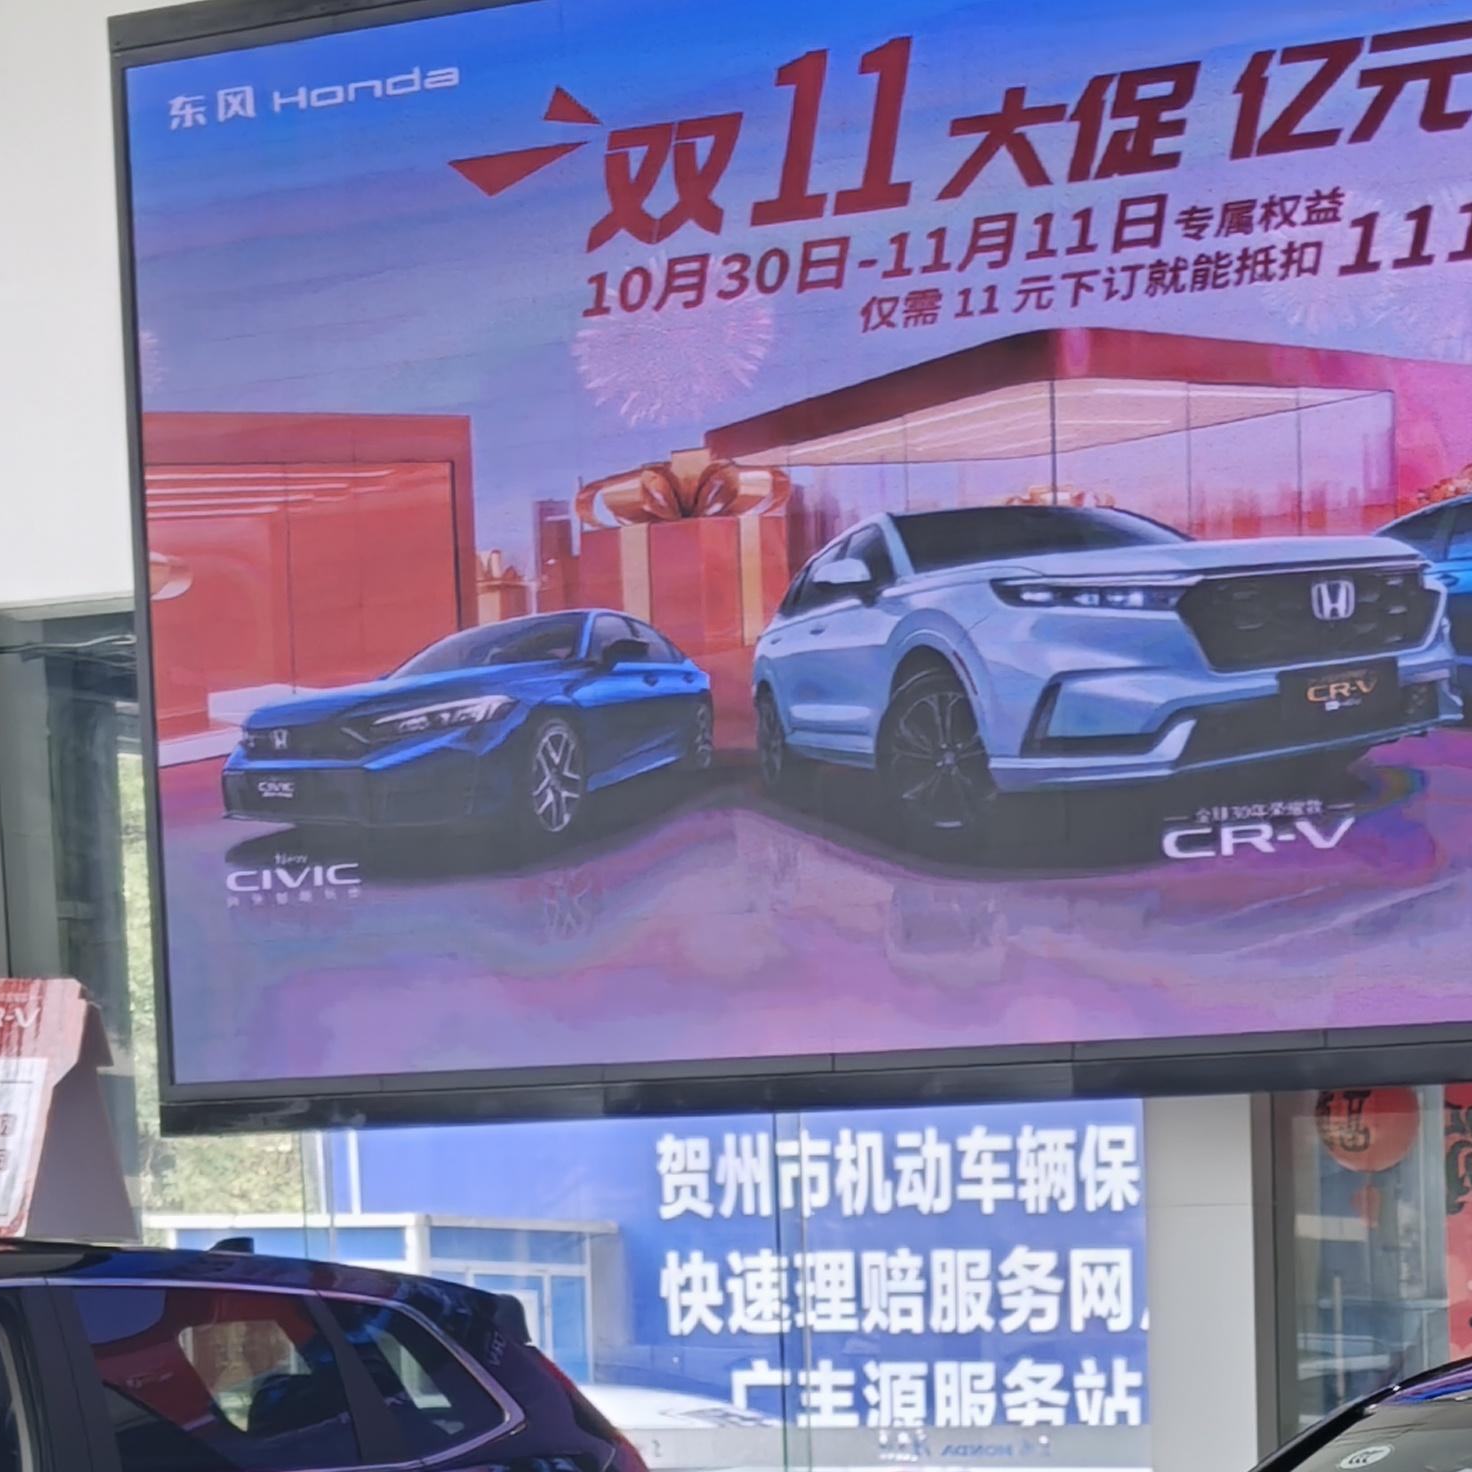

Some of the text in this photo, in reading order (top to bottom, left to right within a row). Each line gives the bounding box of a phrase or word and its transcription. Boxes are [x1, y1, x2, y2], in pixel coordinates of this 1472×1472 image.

[168, 66, 460, 131] 东风 Honda
[1306, 678, 1377, 703] CR-V
[1162, 816, 1356, 860] CR-V
[226, 863, 362, 892] CIVIC
[655, 1122, 1142, 1221] 贺州市机动车辆保
[659, 1244, 1150, 1336] 快速理赔服务网
